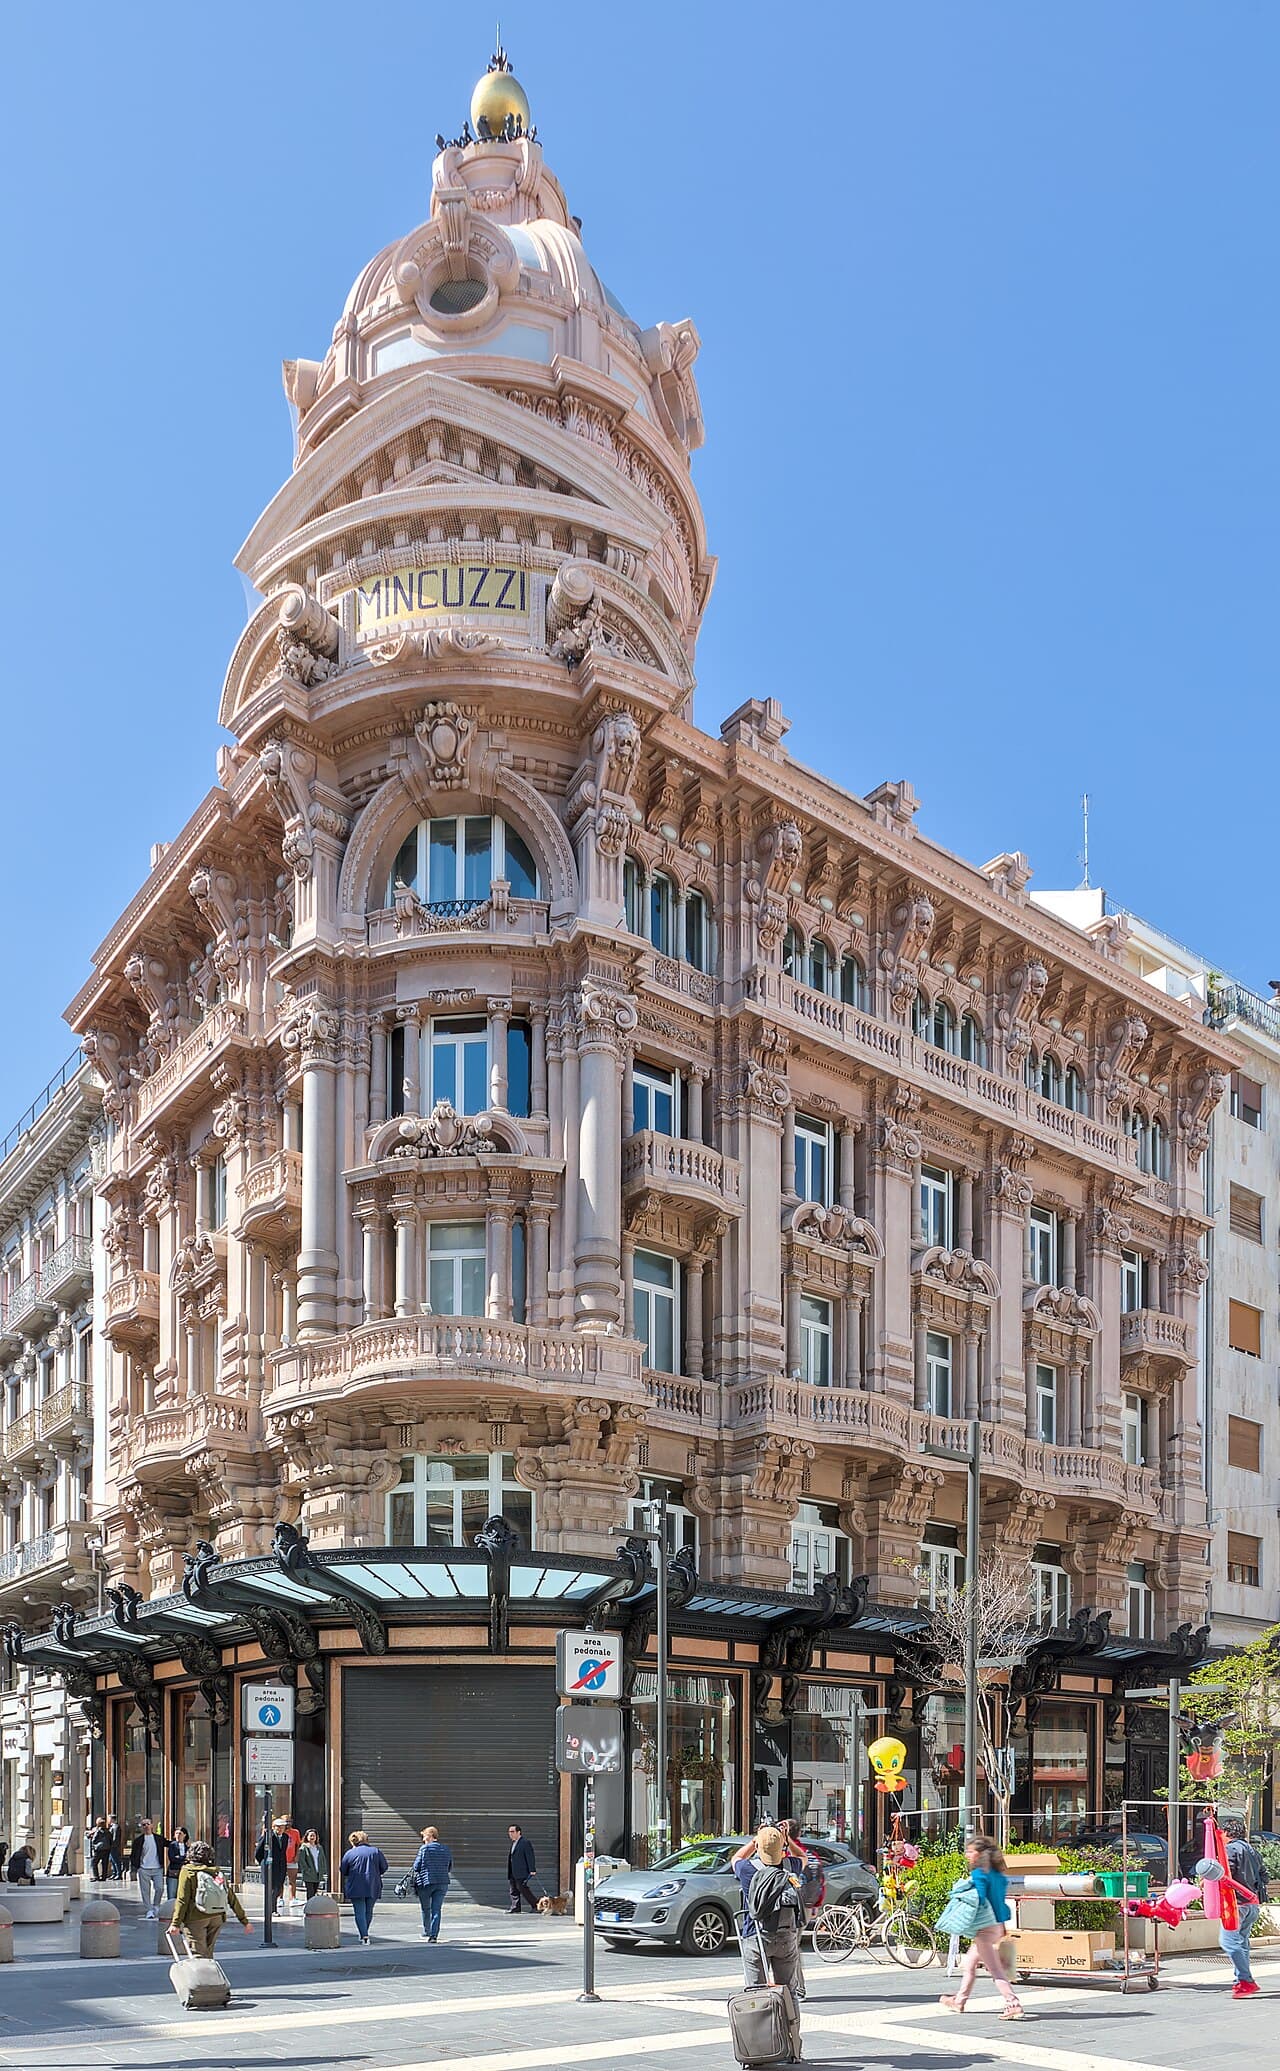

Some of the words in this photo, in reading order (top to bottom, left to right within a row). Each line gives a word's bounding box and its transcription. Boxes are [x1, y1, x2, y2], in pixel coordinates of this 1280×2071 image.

[357, 567, 526, 625] MINCUZZI
[583, 1638, 601, 1646] area
[574, 1646, 611, 1657] pedonale
[254, 1695, 285, 1703] pedonale
[1056, 1954, 1087, 1968] sylber
